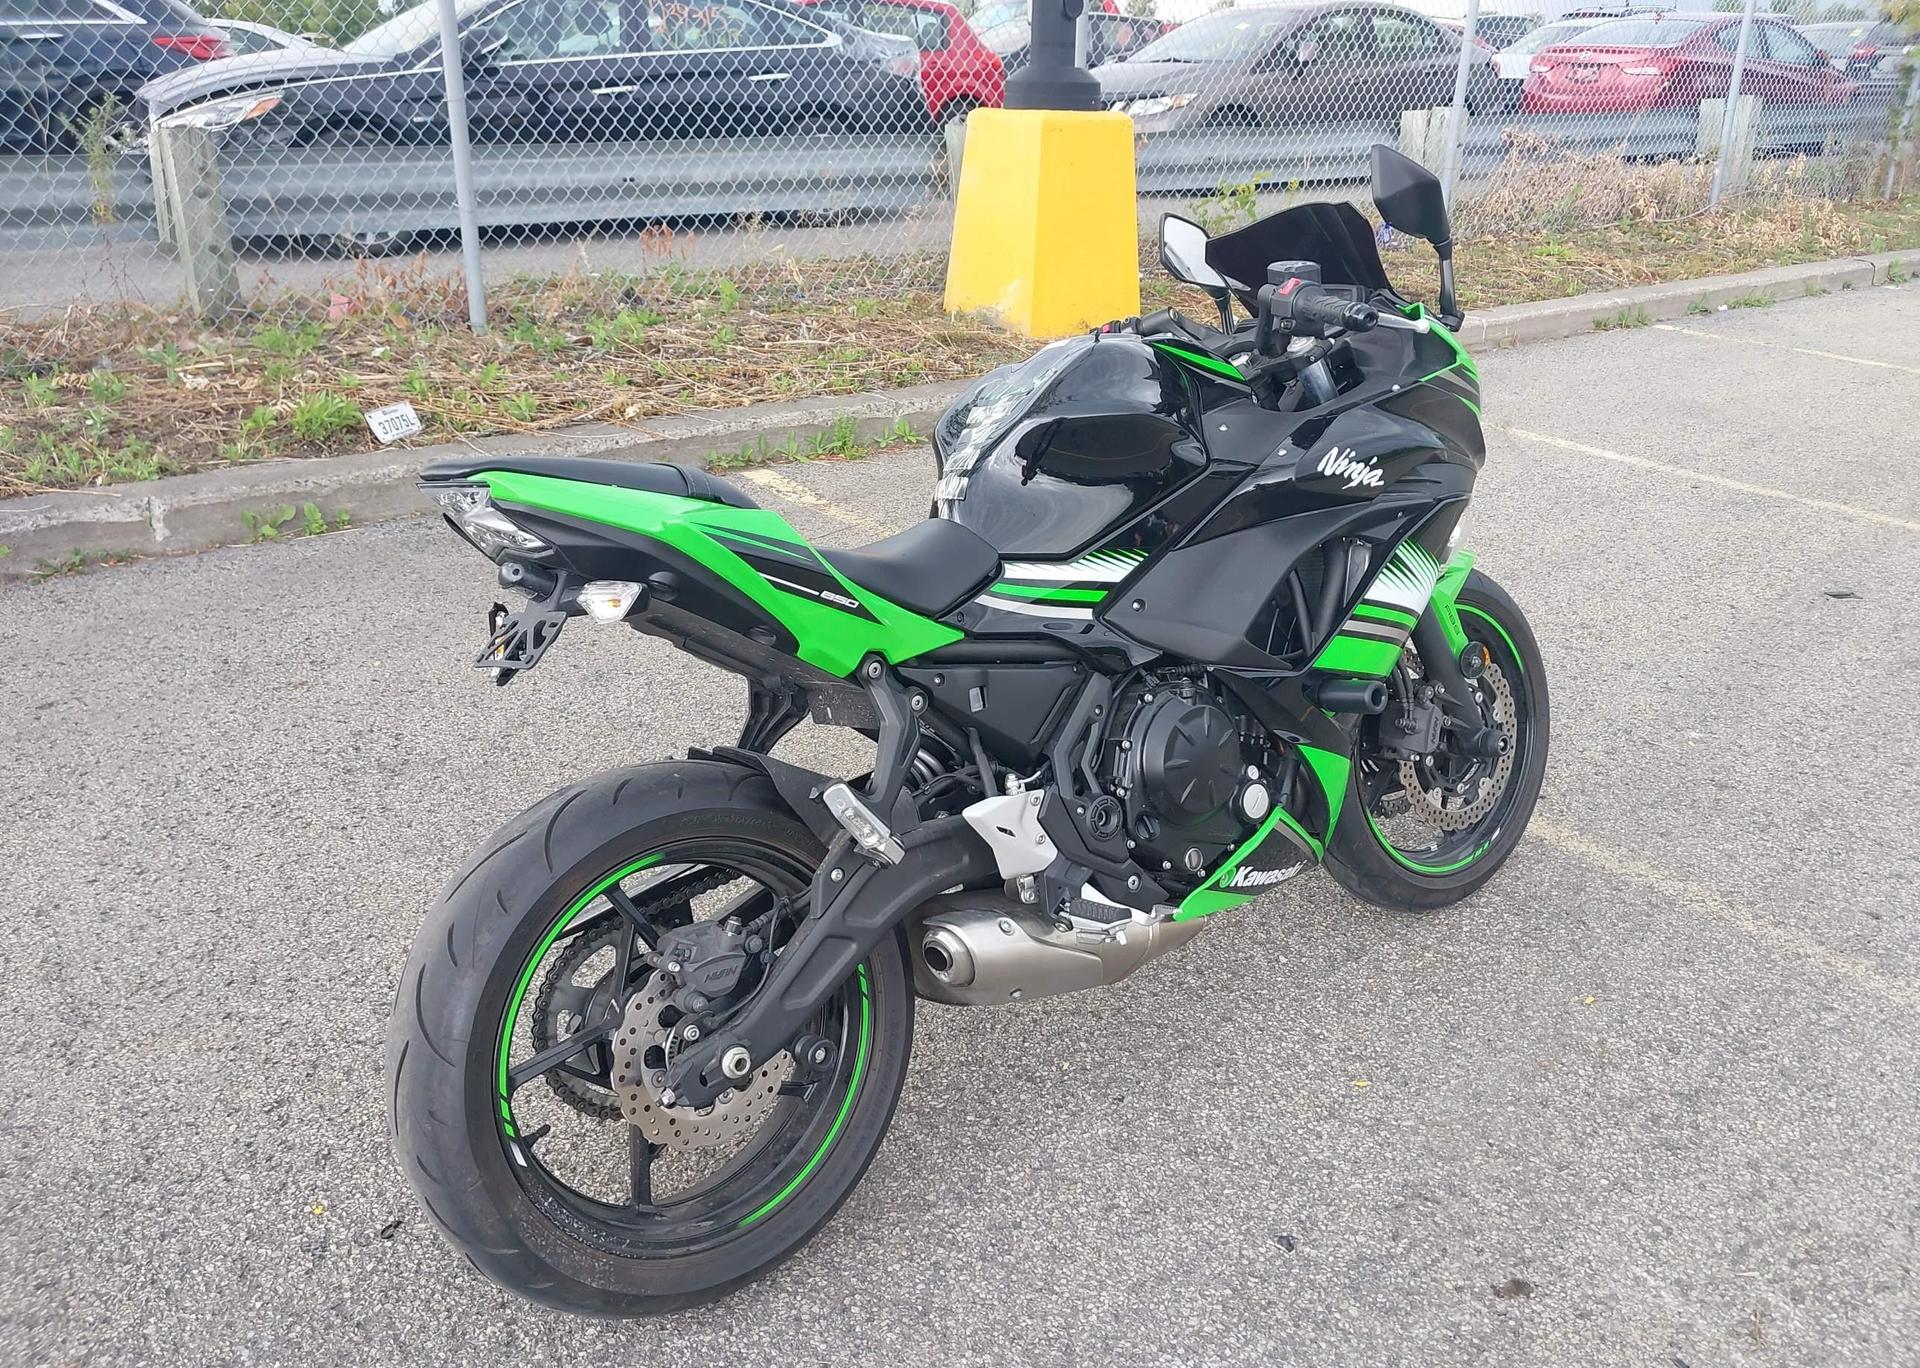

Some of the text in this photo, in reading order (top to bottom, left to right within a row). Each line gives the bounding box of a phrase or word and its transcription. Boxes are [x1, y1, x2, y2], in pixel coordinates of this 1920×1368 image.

[378, 413, 415, 435] 37075L
[1317, 446, 1384, 489] Ninja
[820, 590, 860, 608] 650
[1230, 860, 1308, 887] Kawasaki
